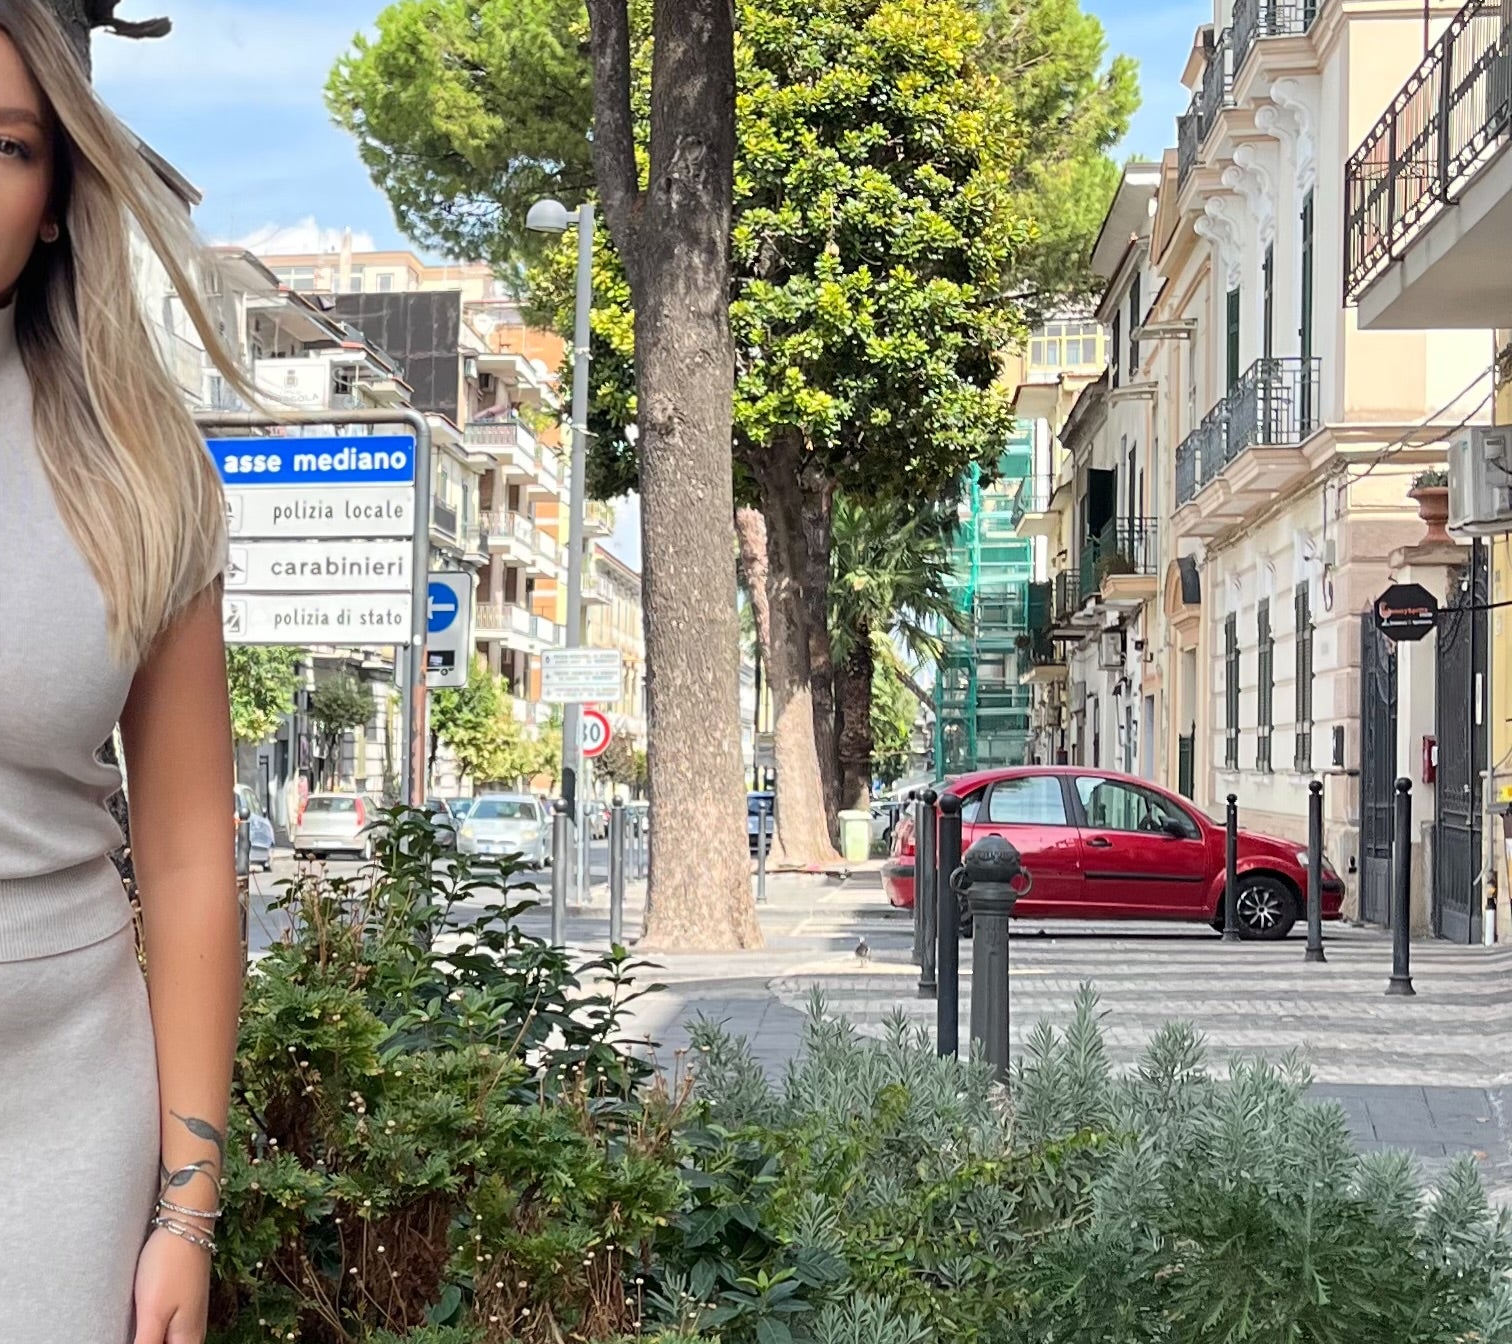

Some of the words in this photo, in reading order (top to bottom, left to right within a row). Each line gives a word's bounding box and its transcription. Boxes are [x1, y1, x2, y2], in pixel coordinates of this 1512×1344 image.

[223, 454, 282, 474] asse
[292, 447, 407, 472] mediano
[273, 500, 334, 525] polizia
[345, 499, 404, 519] locale
[270, 556, 403, 576] carabinieri
[274, 608, 329, 629] polizia
[337, 609, 351, 626] di
[359, 609, 403, 626] stato
